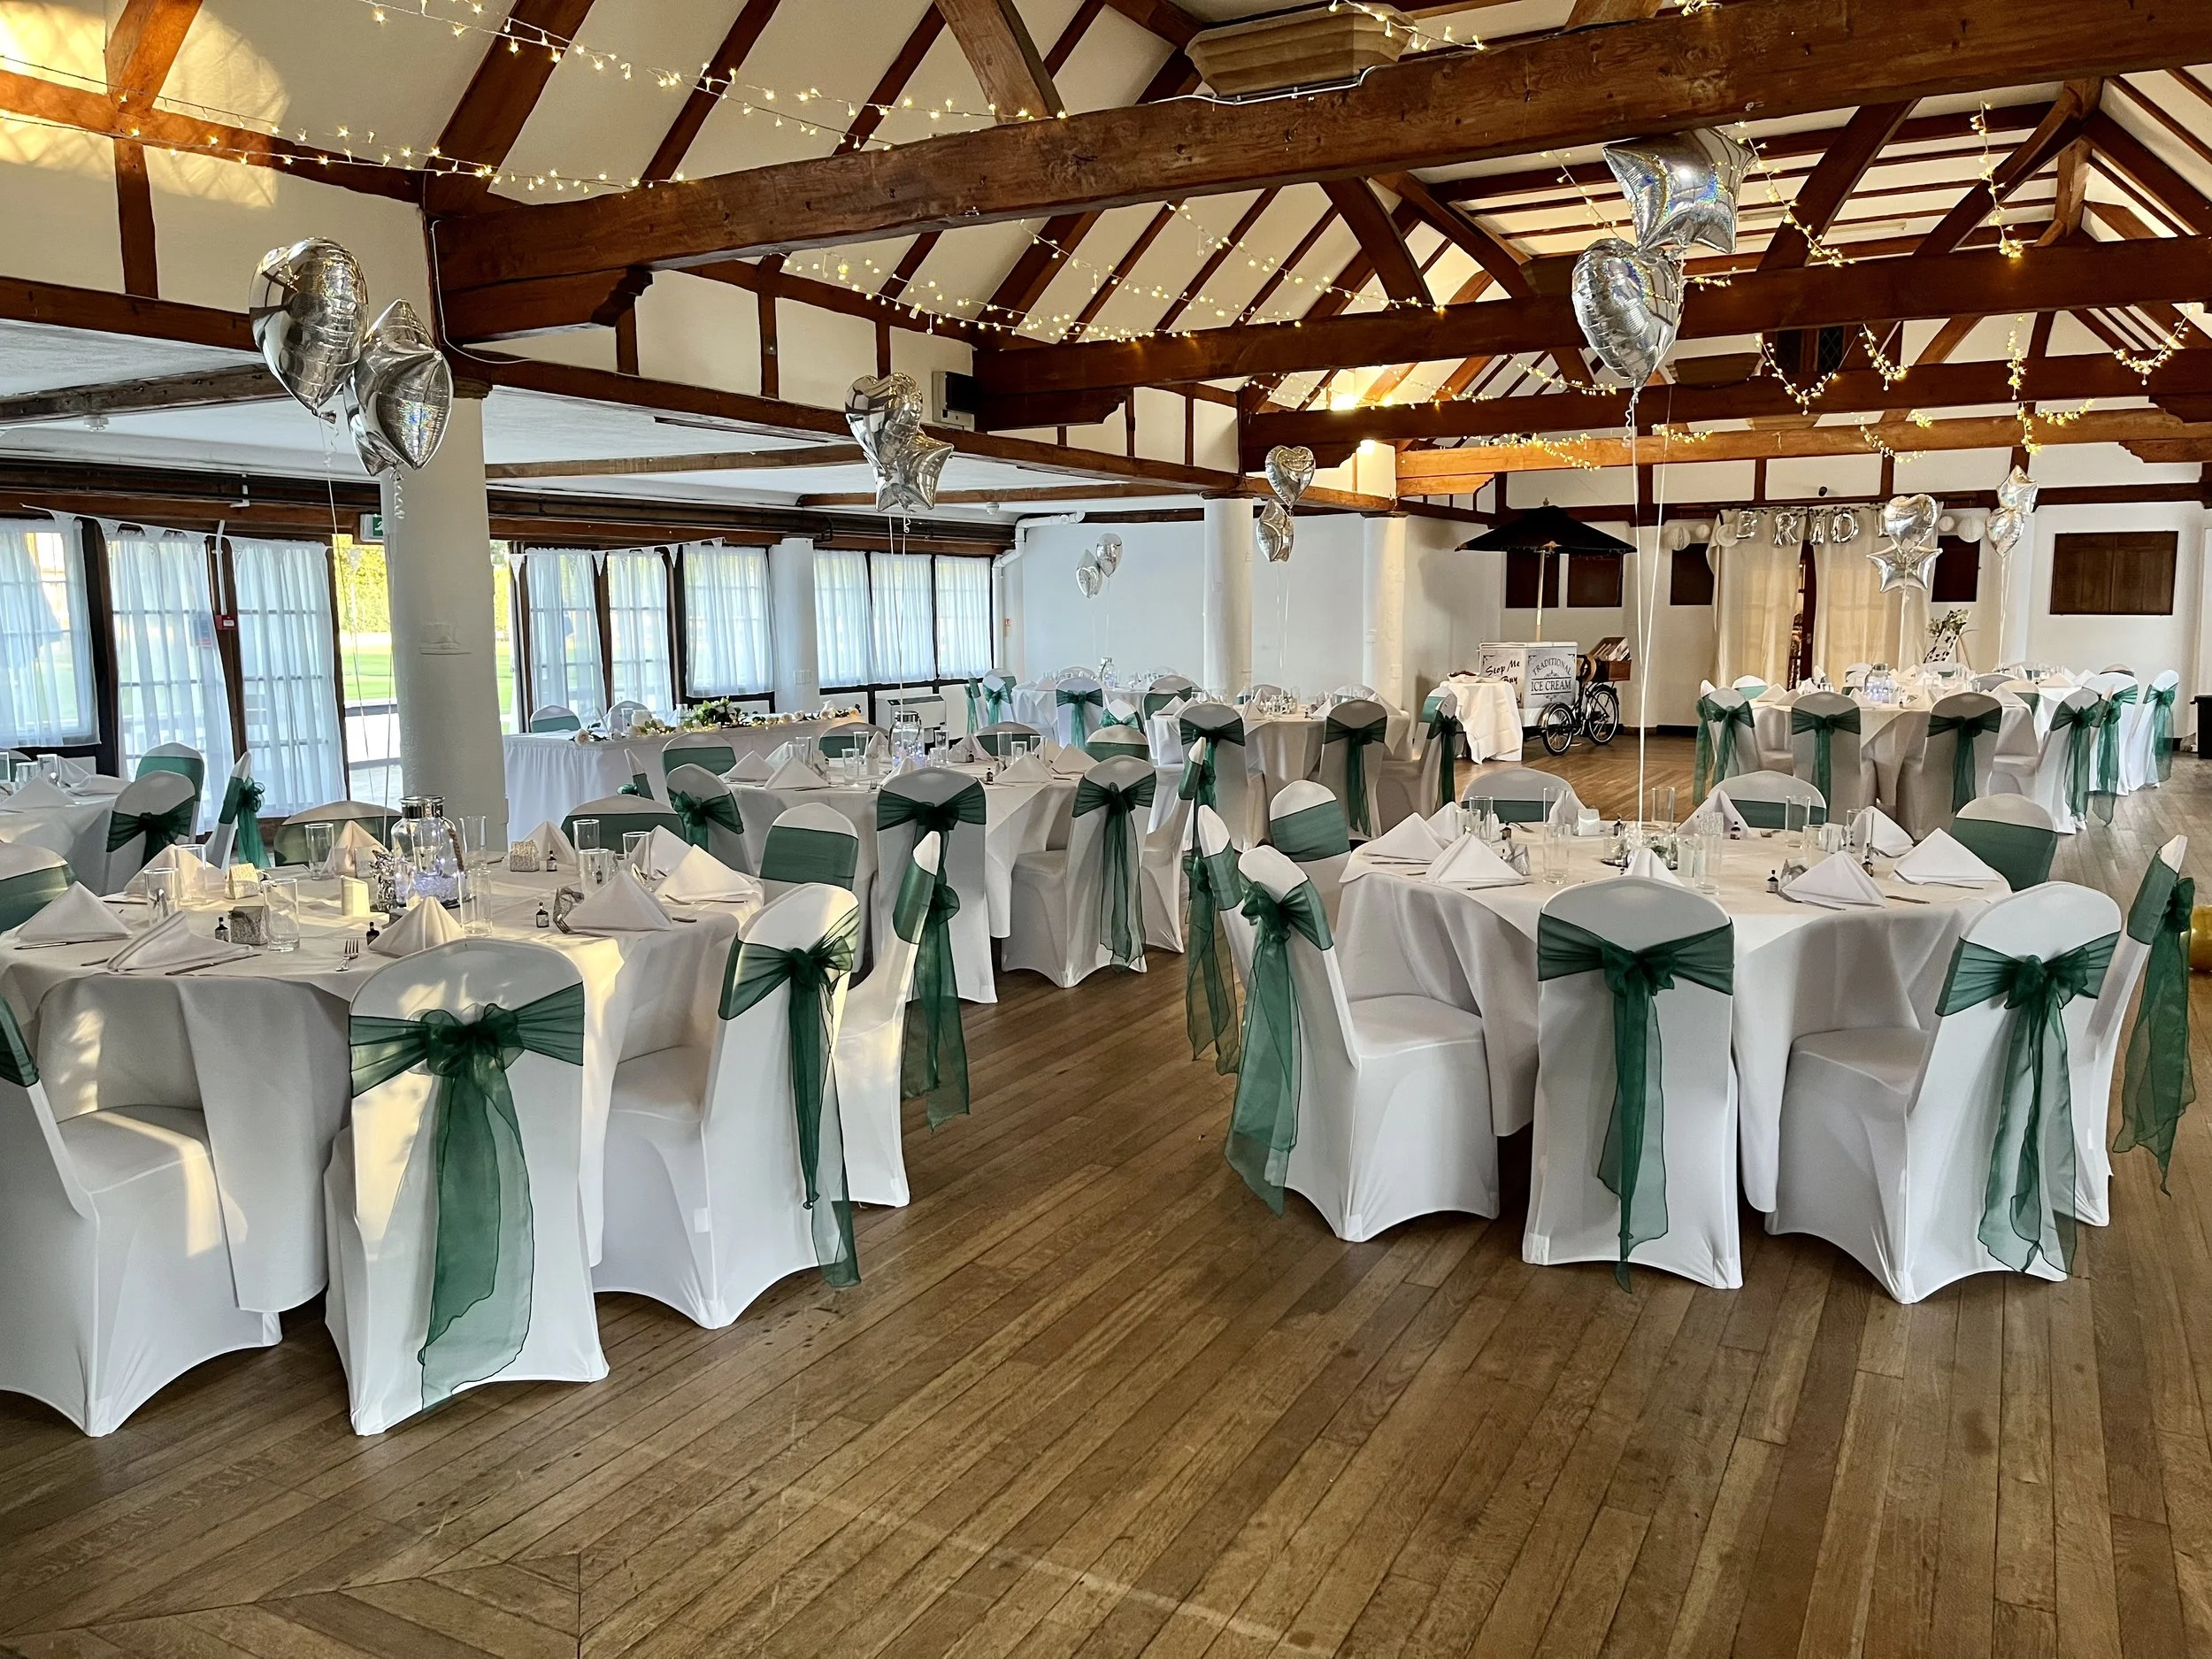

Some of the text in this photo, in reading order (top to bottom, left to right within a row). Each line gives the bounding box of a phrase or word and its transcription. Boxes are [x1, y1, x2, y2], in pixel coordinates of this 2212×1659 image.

[1485, 659, 1520, 676] Stop Me
[1532, 657, 1571, 676] TRADITIONAL
[1531, 680, 1571, 692] ICE CREAM
